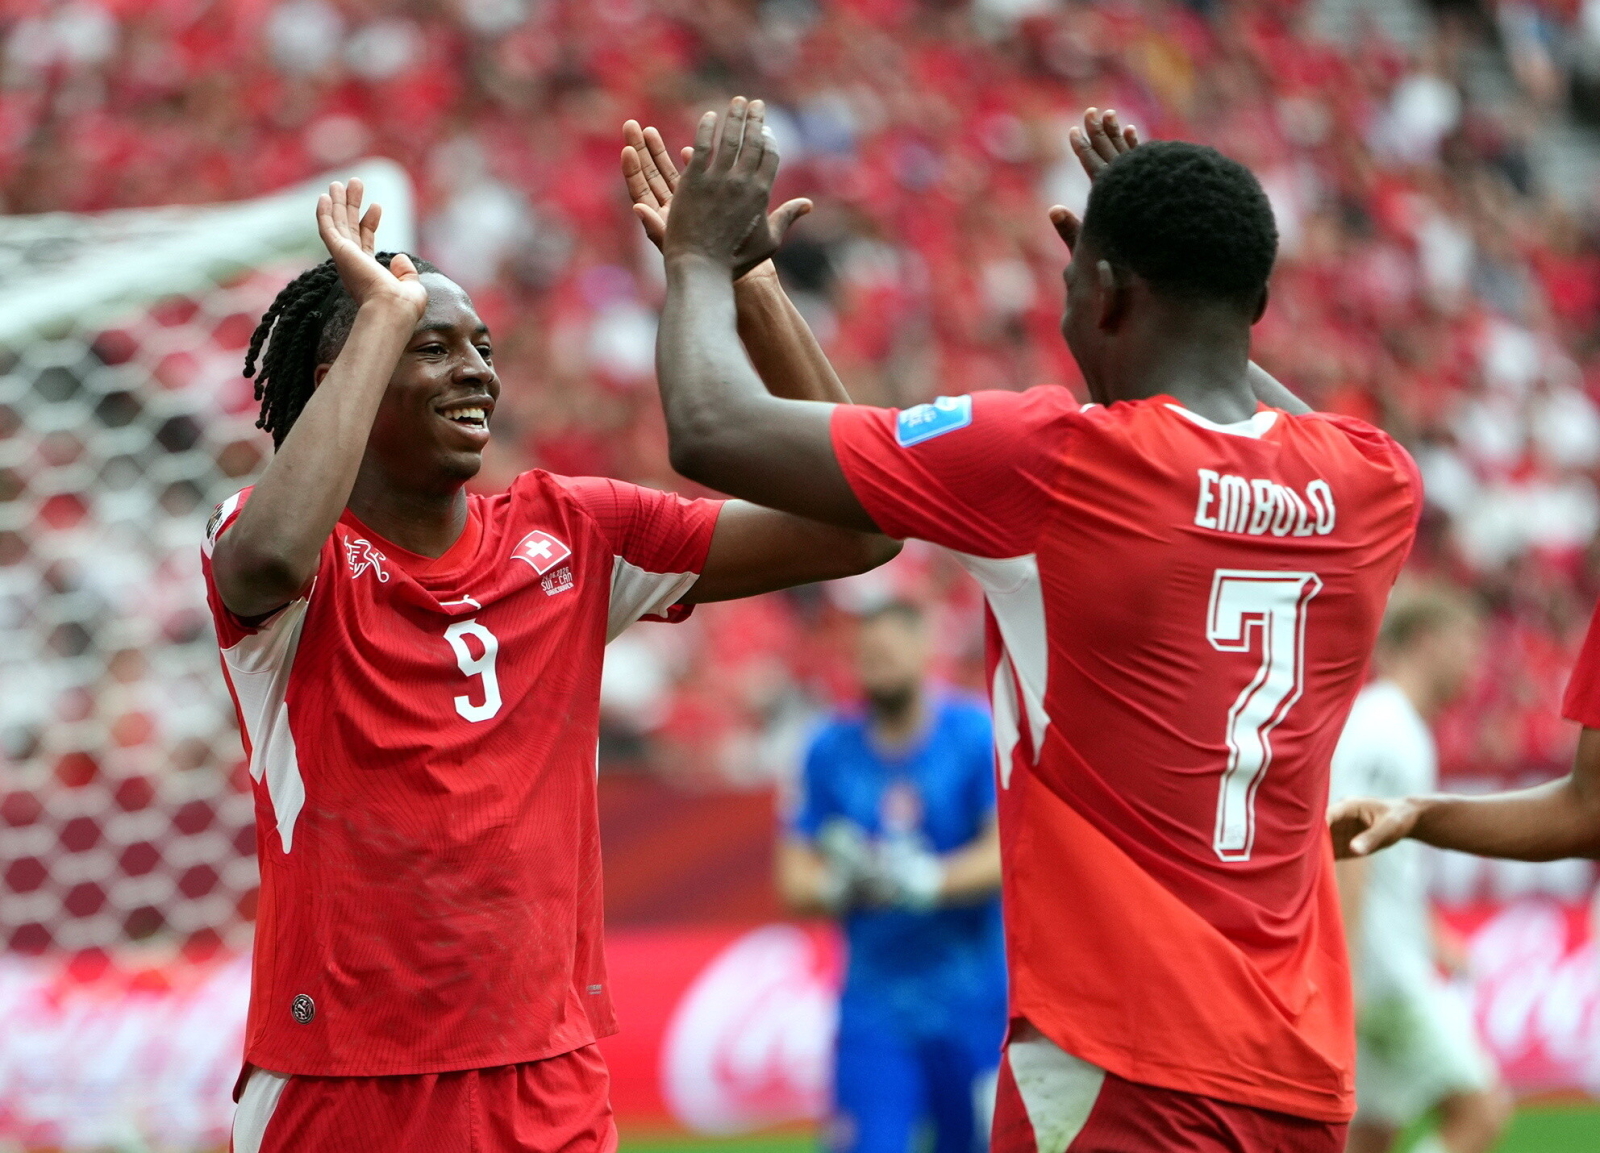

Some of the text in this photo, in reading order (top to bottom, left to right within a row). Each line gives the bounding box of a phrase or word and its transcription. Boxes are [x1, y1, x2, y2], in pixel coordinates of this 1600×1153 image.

[1194, 469, 1336, 537] EMBOLO
[541, 579, 553, 591] SUI
[559, 572, 572, 585] CAN
[443, 618, 502, 723] 9
[1206, 569, 1323, 862] 7
